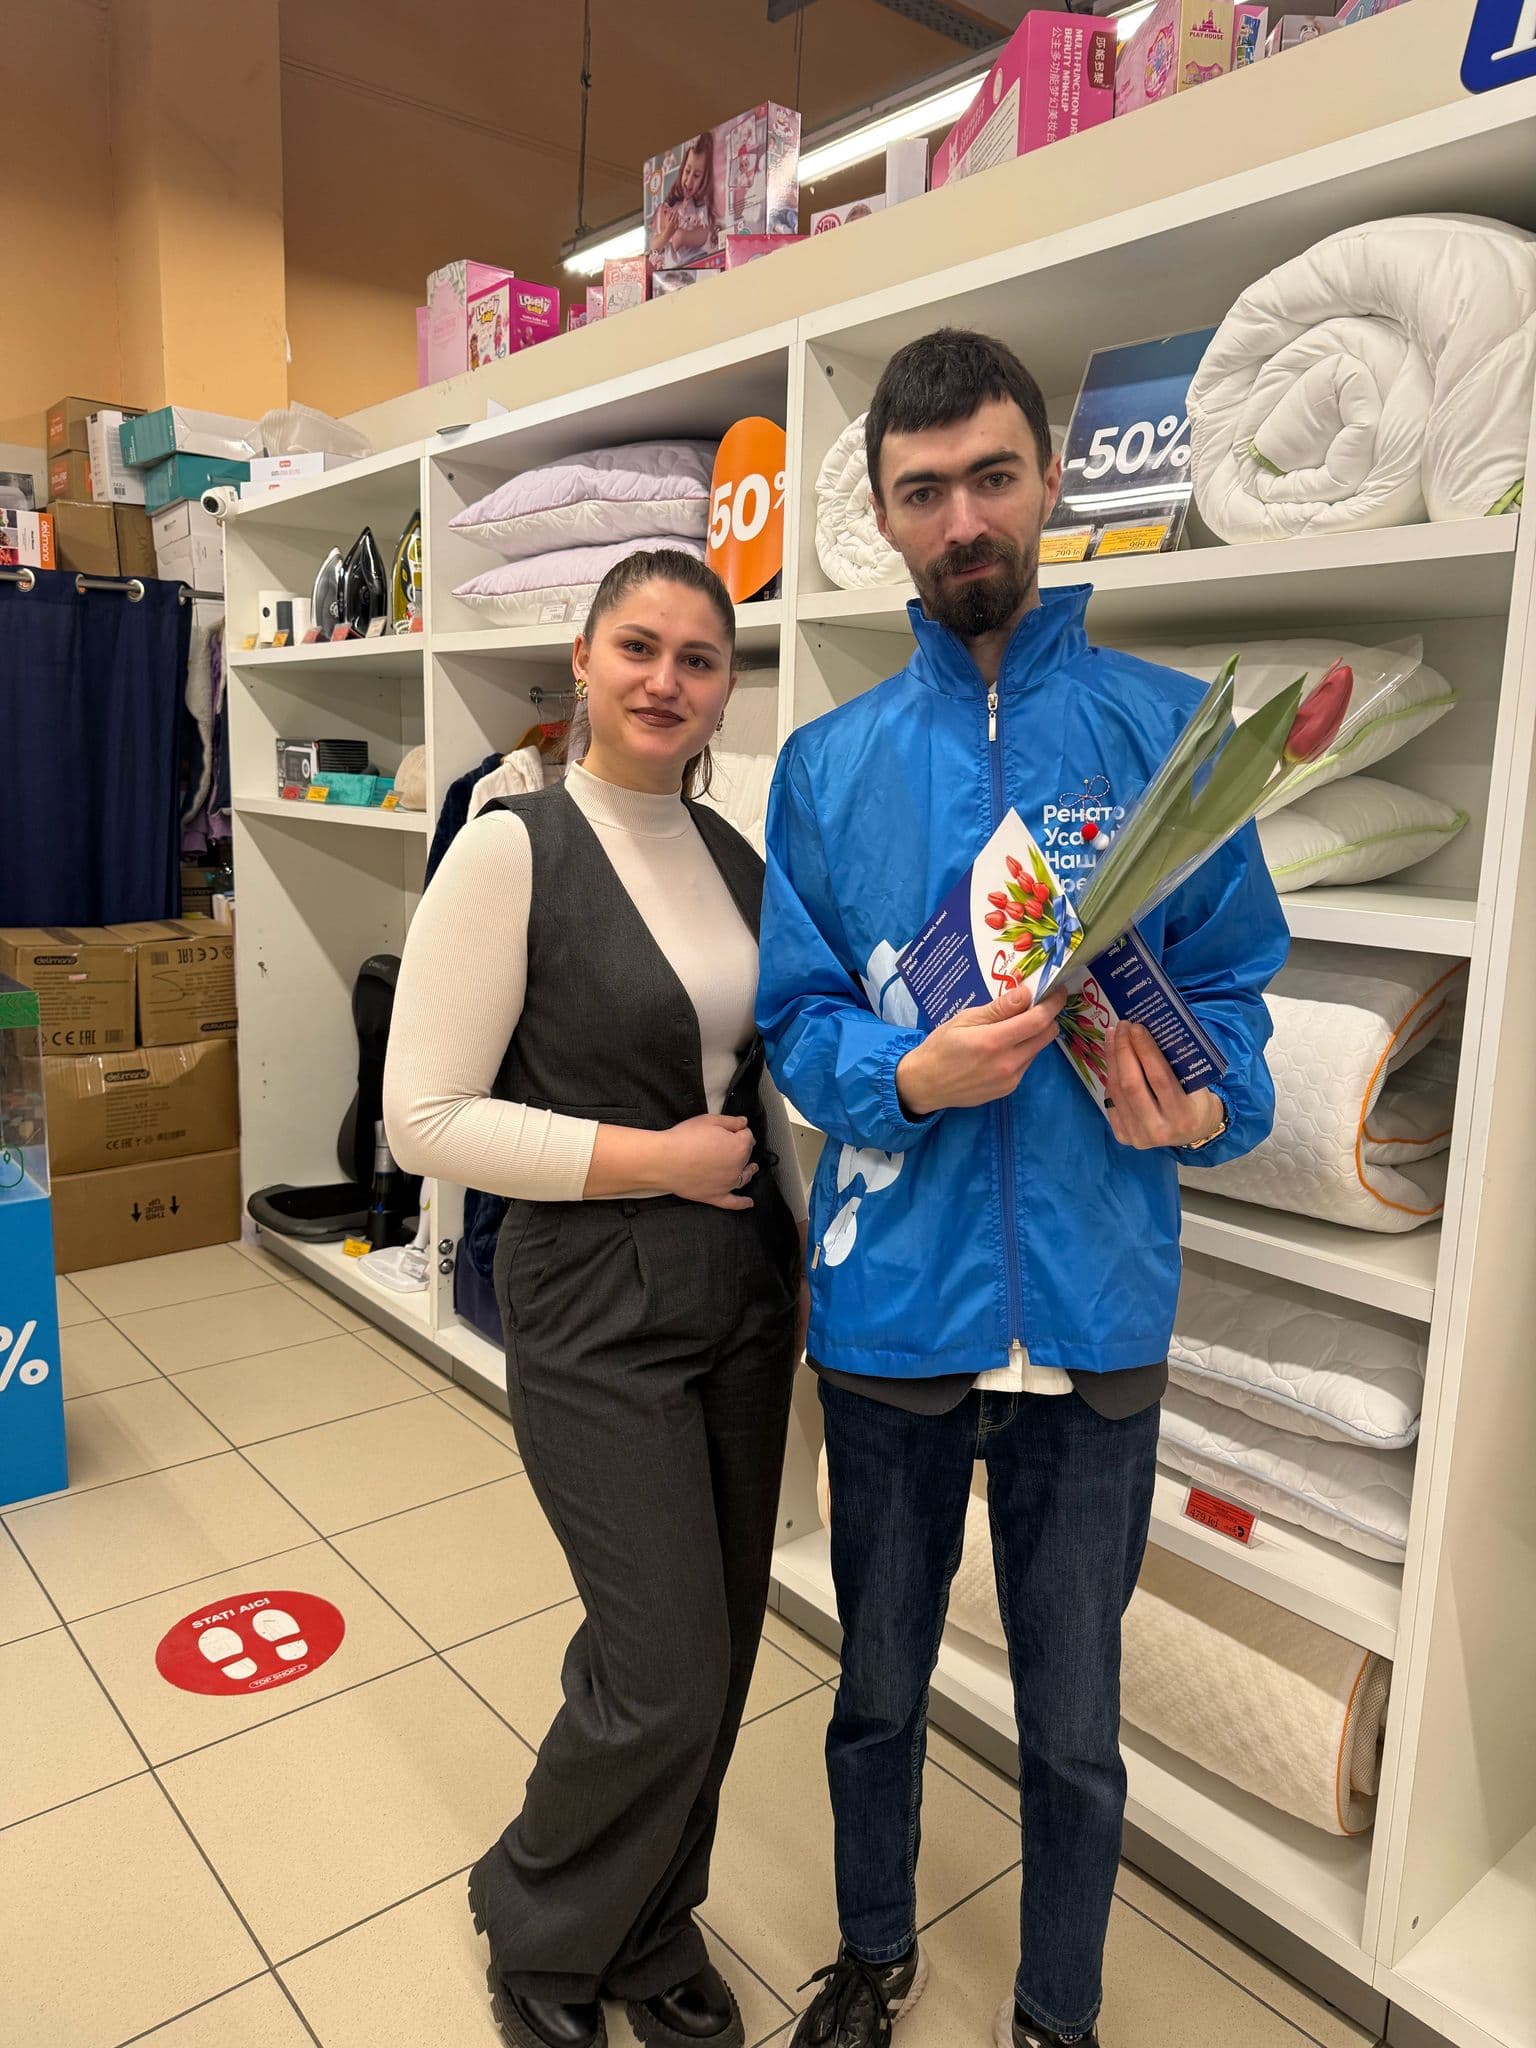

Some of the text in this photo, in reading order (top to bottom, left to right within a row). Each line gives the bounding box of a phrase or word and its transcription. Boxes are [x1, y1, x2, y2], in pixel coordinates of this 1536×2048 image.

[1061, 27, 1072, 112] BEAUTY MAKEUP
[1071, 28, 1083, 116] MULTI-FUNCTION
[1067, 415, 1192, 480] -50%
[1043, 805, 1125, 824] Ренато
[239, 1597, 272, 1614] AICI
